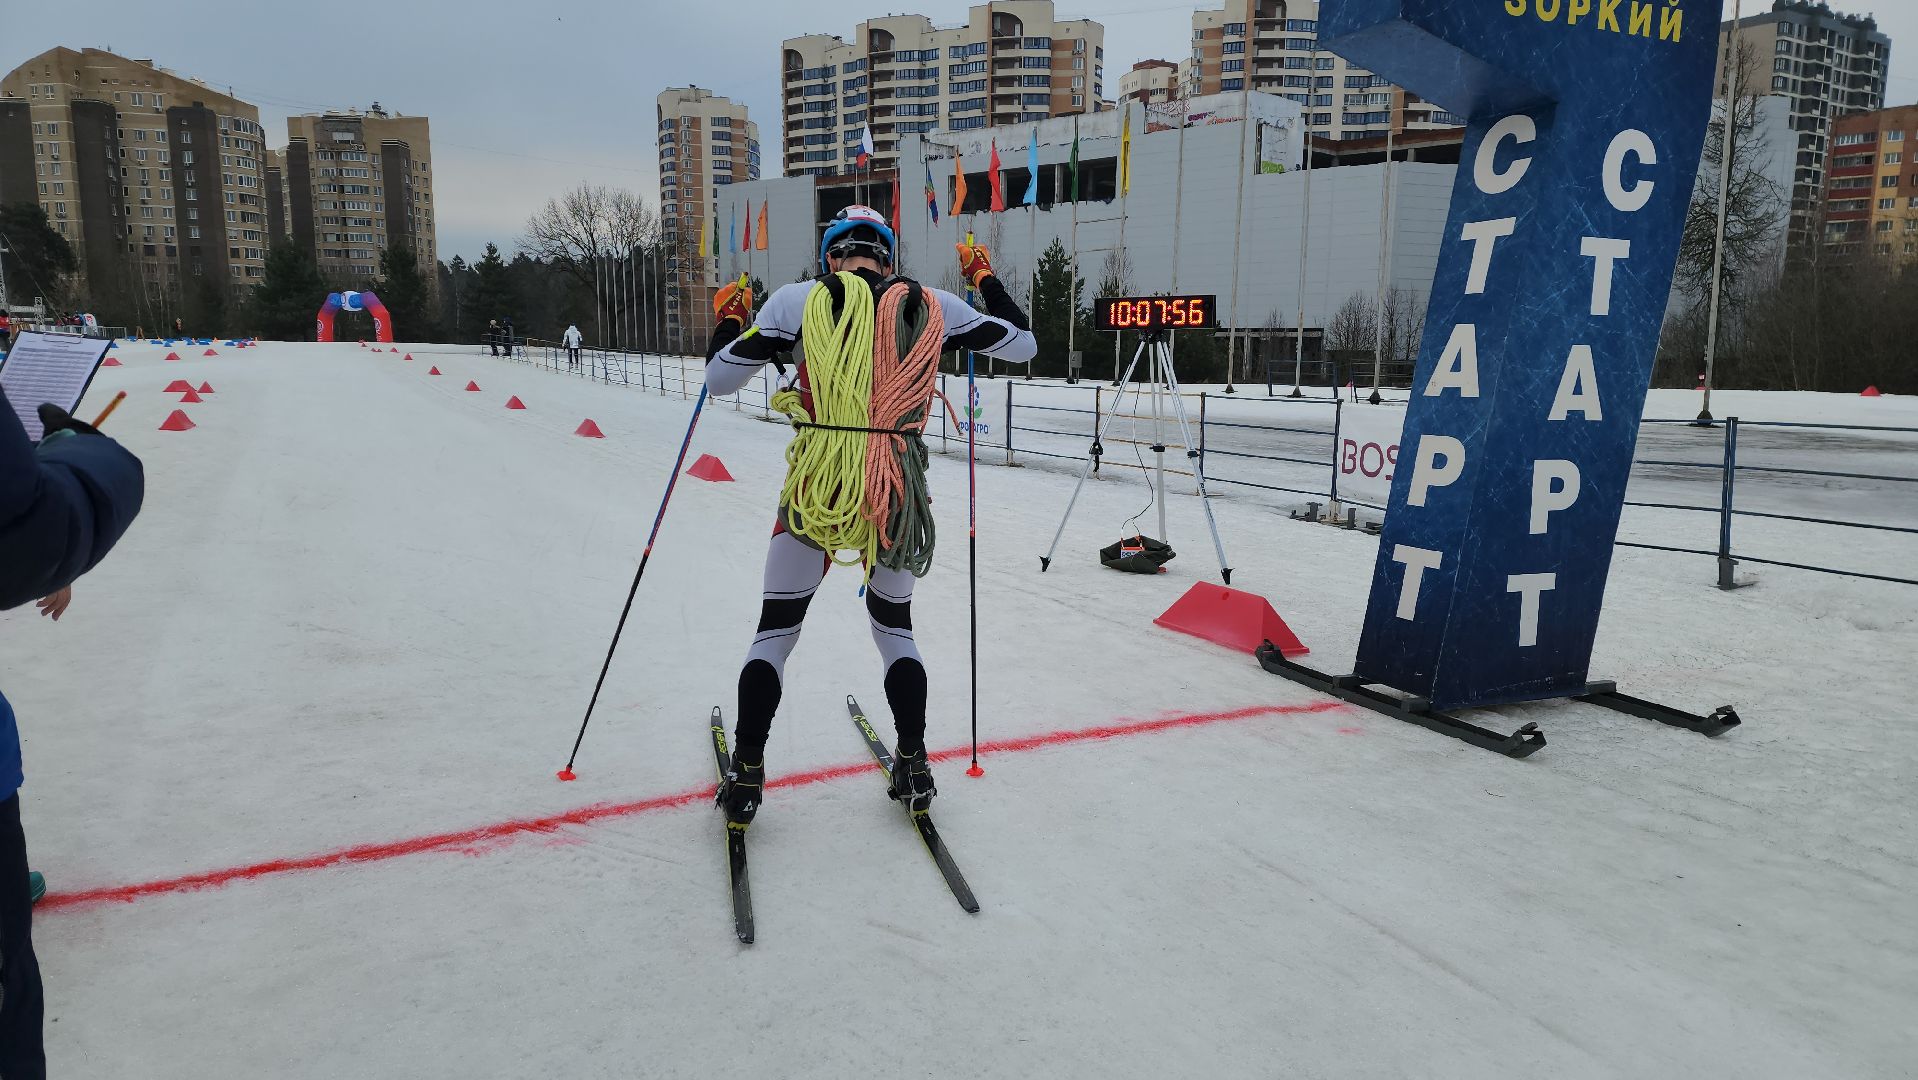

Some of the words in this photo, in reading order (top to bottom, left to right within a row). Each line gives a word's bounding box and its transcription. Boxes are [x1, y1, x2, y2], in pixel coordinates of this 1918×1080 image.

[1110, 299, 1204, 326] 10:07:56
[1392, 114, 1537, 621] СТАРТ
[1507, 128, 1657, 647] СТАРТ
